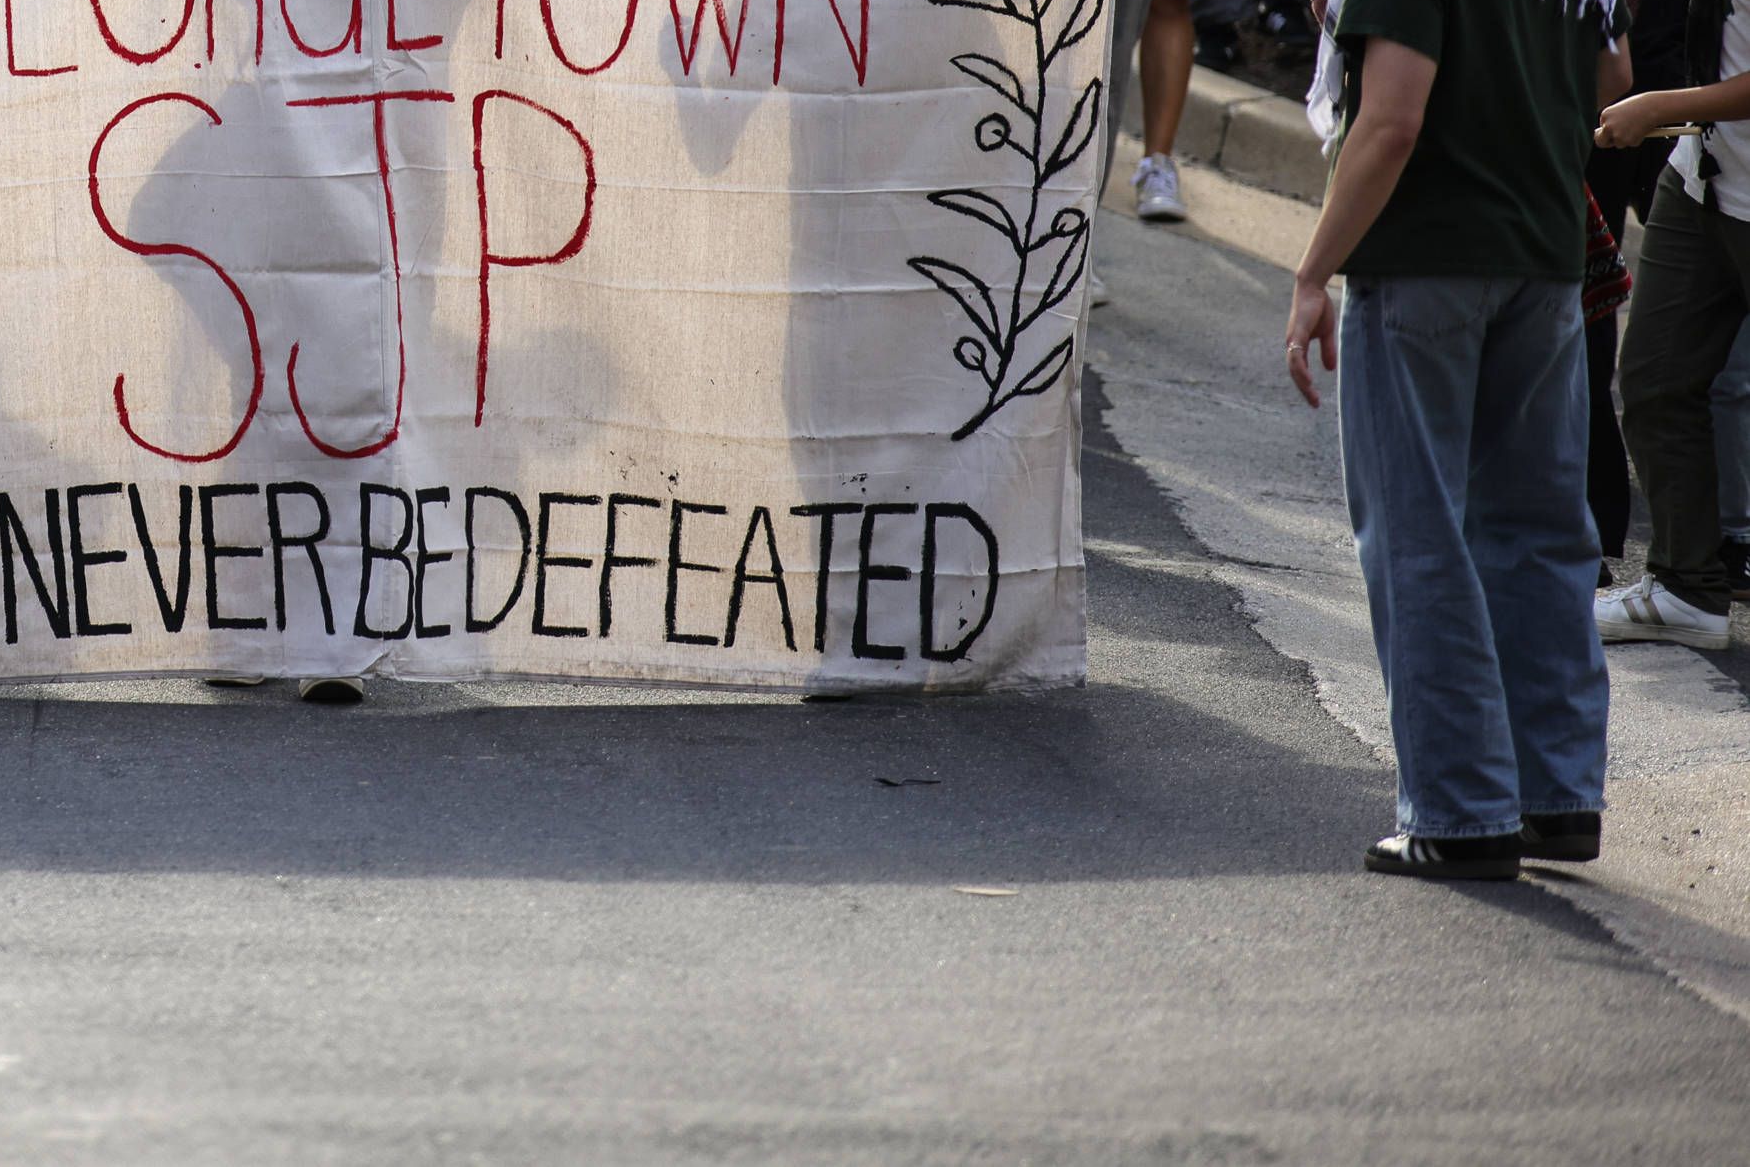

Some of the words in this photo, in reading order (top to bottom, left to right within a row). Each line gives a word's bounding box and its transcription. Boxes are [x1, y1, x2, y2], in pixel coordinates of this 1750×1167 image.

[87, 88, 596, 465] SJP
[352, 482, 455, 642] BE
[463, 485, 1001, 666] DEFEATED
